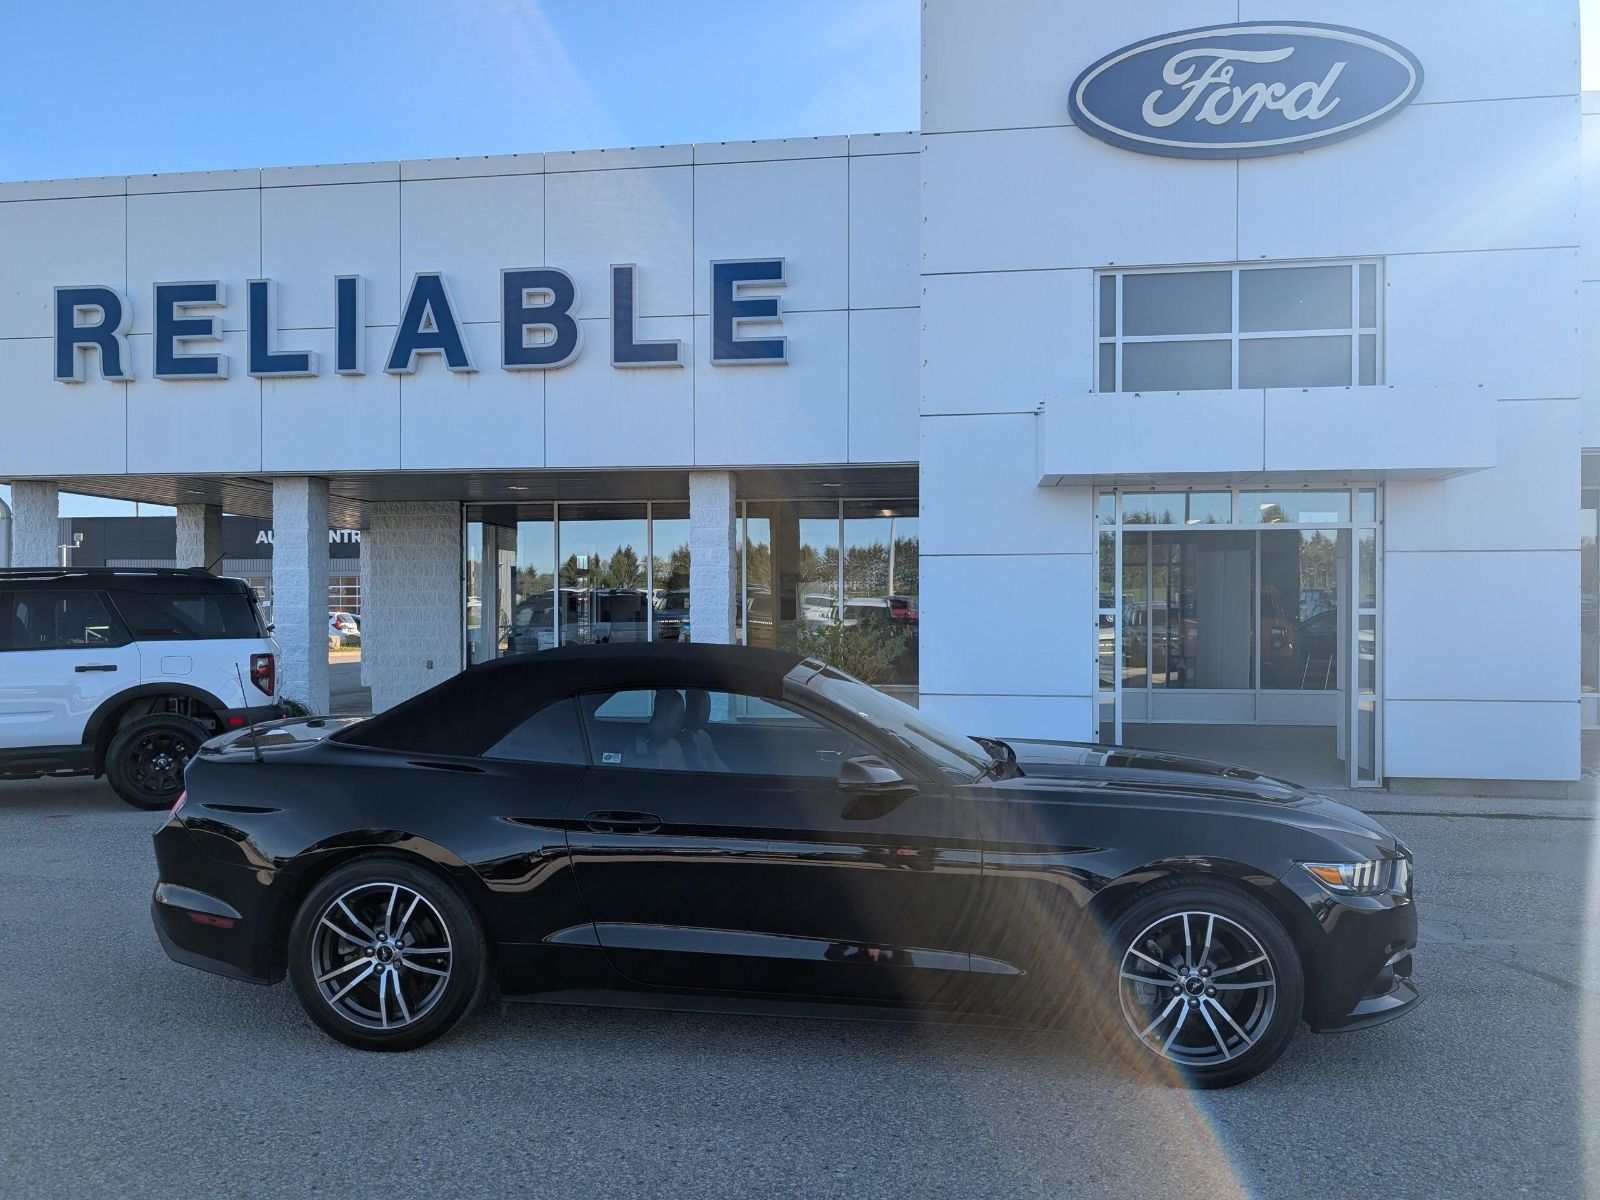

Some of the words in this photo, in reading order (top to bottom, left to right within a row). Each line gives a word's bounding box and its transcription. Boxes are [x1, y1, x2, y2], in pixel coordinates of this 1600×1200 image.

[1141, 46, 1348, 128] Ford
[53, 257, 788, 384] RELIABLE
[328, 529, 361, 543] NTR
